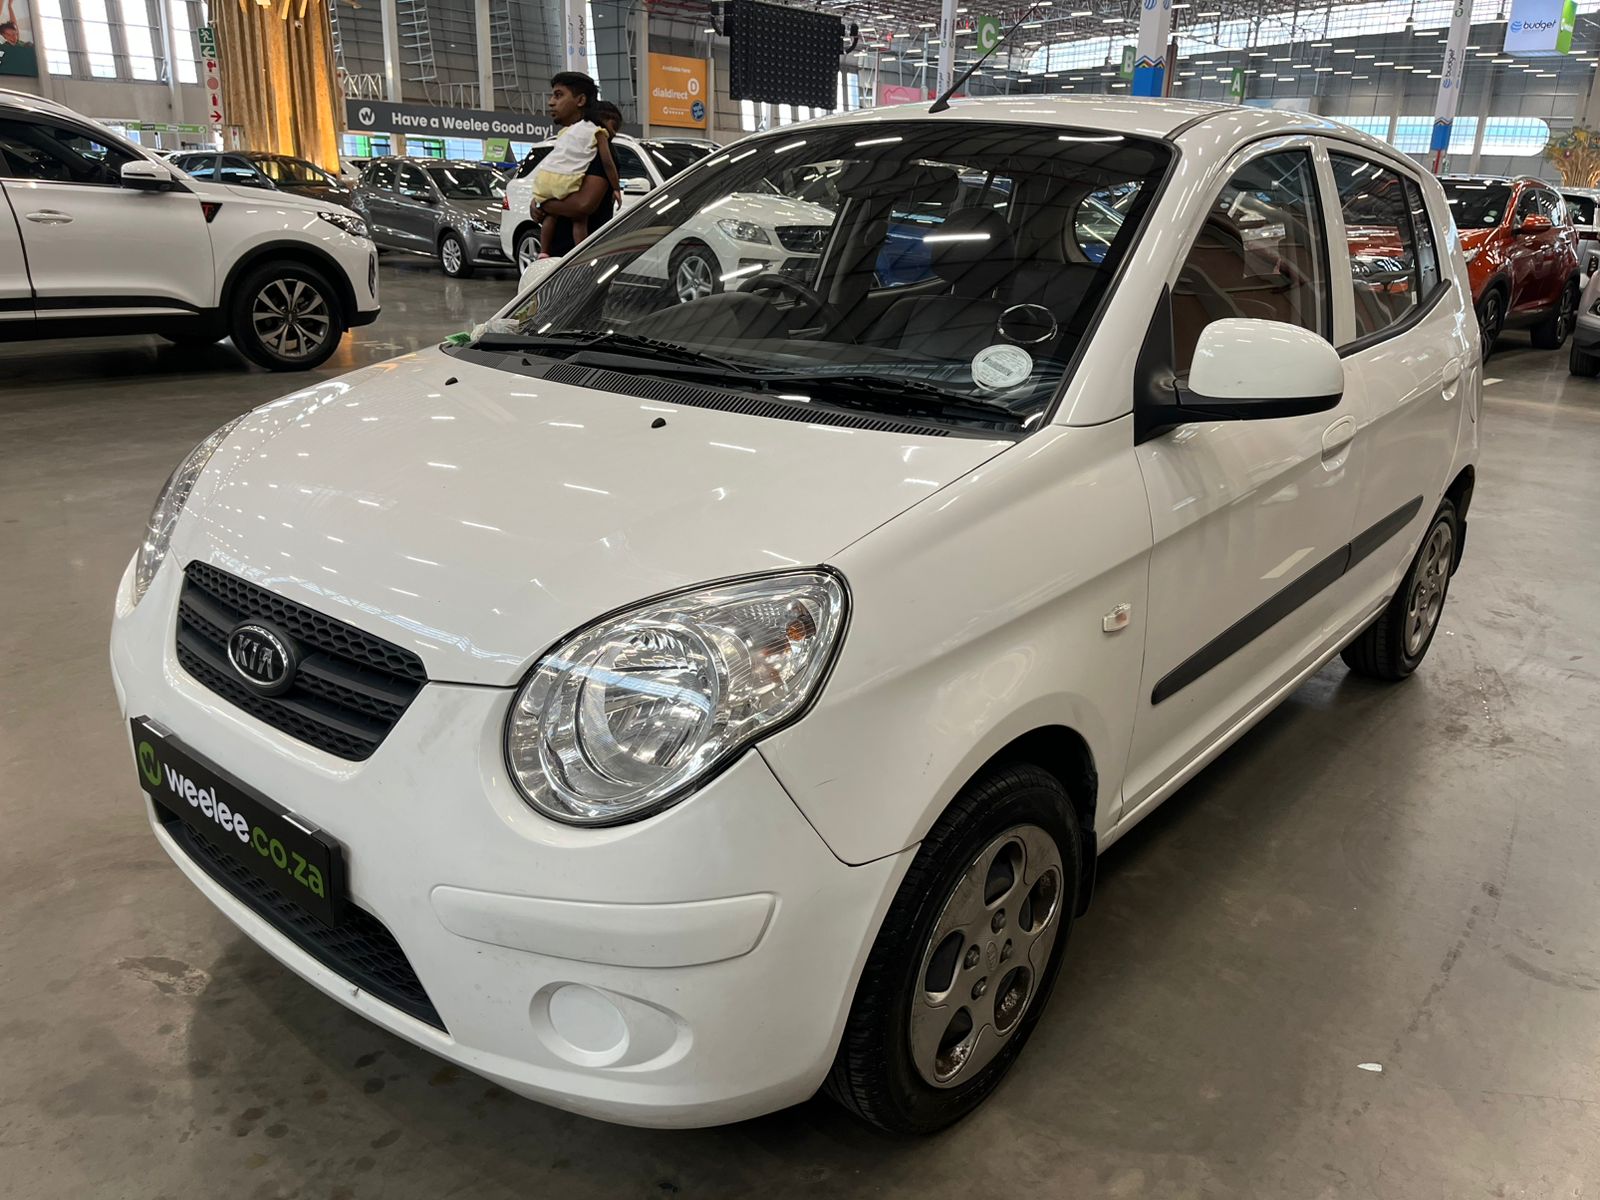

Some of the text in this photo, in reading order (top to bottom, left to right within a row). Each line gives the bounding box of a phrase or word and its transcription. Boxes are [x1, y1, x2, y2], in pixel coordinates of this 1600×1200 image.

[578, 15, 586, 45] budget
[981, 23, 996, 48] C
[1523, 19, 1557, 32] budget
[1124, 51, 1134, 73] B
[1445, 48, 1457, 78] budget
[652, 88, 688, 100] dialdirect
[1231, 72, 1241, 93] A
[392, 112, 554, 138] Have a Weelee Good Day!
[235, 634, 274, 680] KIA
[164, 763, 325, 899] weelee.co.za
